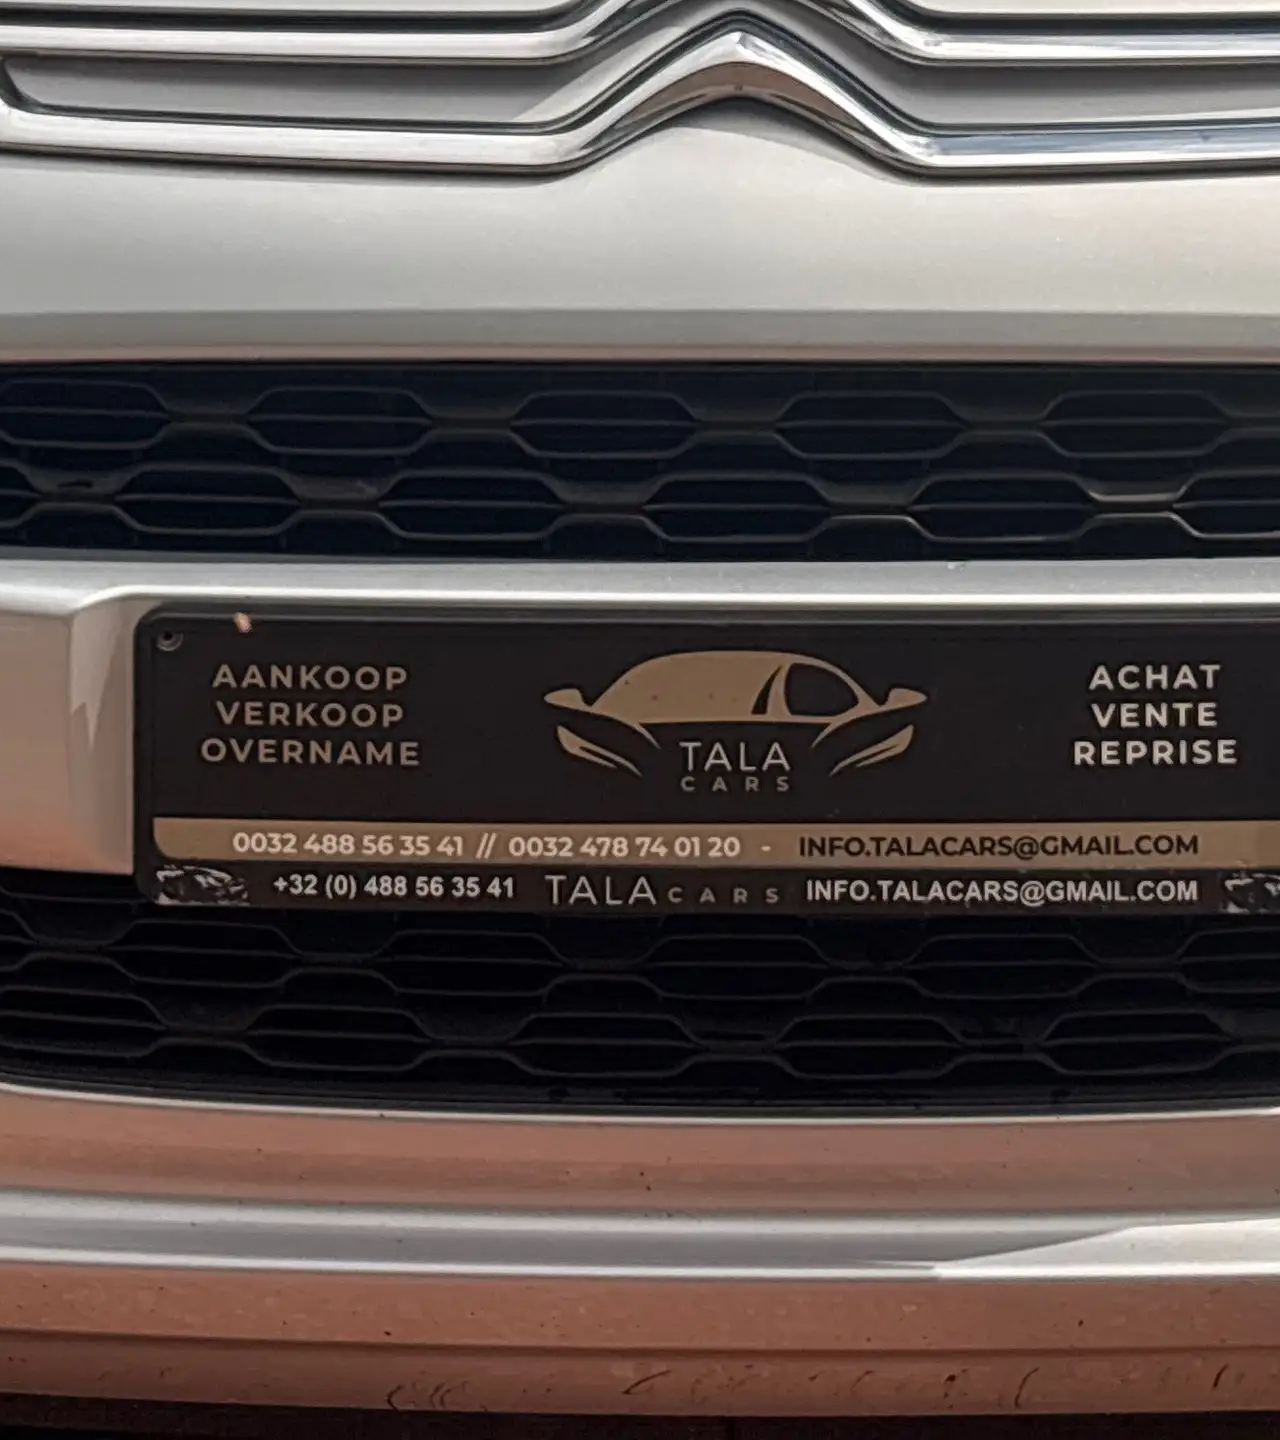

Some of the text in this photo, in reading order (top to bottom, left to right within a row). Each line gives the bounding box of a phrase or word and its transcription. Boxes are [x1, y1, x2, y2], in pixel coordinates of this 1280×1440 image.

[211, 663, 408, 692] AANKOOP
[1088, 663, 1221, 691] ACHAT
[215, 700, 404, 728] VERKOOP
[1091, 701, 1219, 728] VENTE
[200, 737, 420, 766] OVERNAME
[679, 741, 791, 772] TALA
[1073, 738, 1238, 766] REPRISE
[680, 775, 790, 792] CARS
[232, 832, 298, 854] 0032
[303, 833, 355, 855] 488
[361, 834, 394, 856] 56
[399, 835, 430, 857] 35
[436, 835, 463, 857] 41
[508, 836, 573, 858] 0032
[579, 836, 629, 858] 478
[635, 836, 668, 858] 74
[673, 836, 701, 858] 01
[707, 836, 741, 858] 20
[799, 834, 1199, 860] INFO.TALACARS@GMAIL.COM
[273, 873, 514, 900] +32 (0) 488 56 35 41
[544, 874, 780, 906] TALA CARS
[806, 879, 1199, 908] INFO.TALACARS@GMAIL.COM
